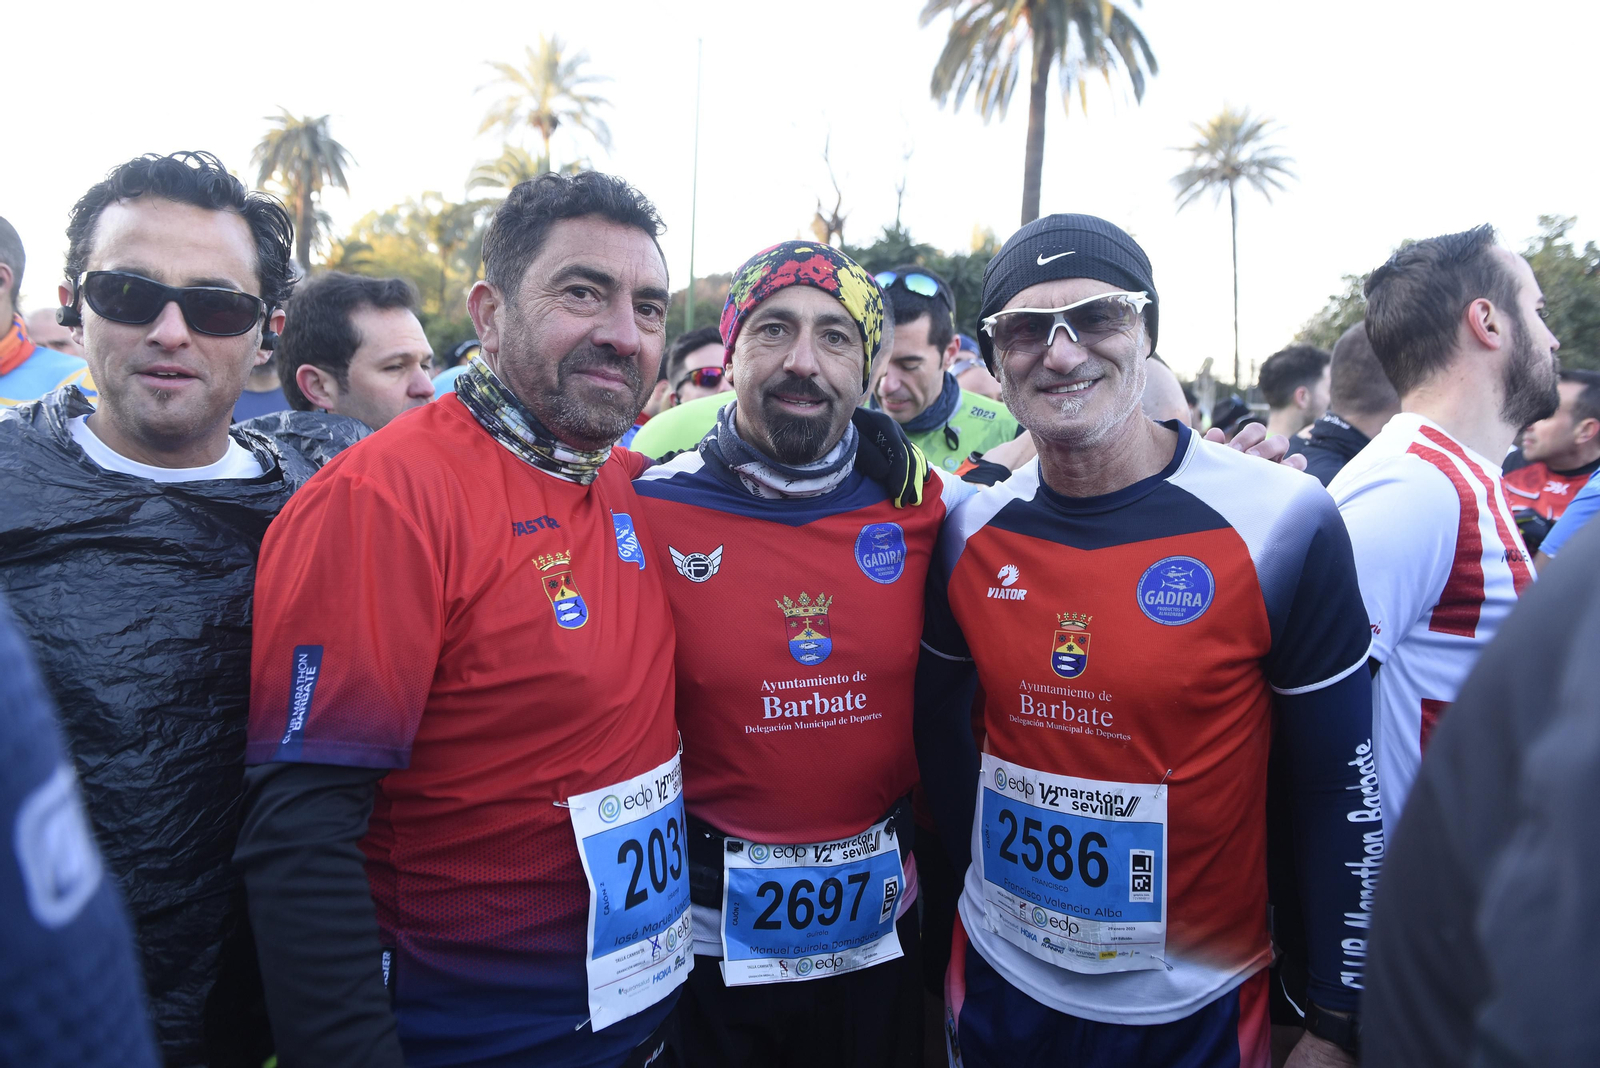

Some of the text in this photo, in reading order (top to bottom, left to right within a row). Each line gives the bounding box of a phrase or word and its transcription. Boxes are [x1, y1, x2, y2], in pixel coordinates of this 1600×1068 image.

[971, 406, 996, 420] 2023
[863, 550, 902, 568] GADIRA
[987, 587, 1028, 600] VIATOR
[1144, 590, 1202, 607] GADIRA
[760, 671, 867, 693] Ayuntamiento de
[1019, 680, 1112, 702] Ayuntamiento de
[292, 666, 317, 731] BARBATE
[761, 689, 867, 720] Barbate
[1020, 693, 1114, 727] Barbate
[745, 721, 792, 734] Delegación
[794, 718, 837, 730] Municipal
[850, 711, 883, 725] Deportes
[1009, 714, 1131, 740] Delegación Municipal de Deportes
[1009, 776, 1034, 798] edp
[1055, 786, 1123, 805] maratón
[1346, 738, 1382, 822] Barbate
[624, 784, 653, 810] edp
[1072, 801, 1124, 817] sevilla
[773, 844, 807, 861] edp
[830, 832, 873, 851] maratón
[843, 843, 876, 859] sevilla
[998, 809, 1108, 888] 2586
[1031, 877, 1069, 892] FRANCISCO
[753, 871, 870, 930] 2697
[1004, 878, 1042, 902] Francisco
[1044, 895, 1090, 915] Valencia
[1095, 907, 1123, 918] Alba
[614, 927, 639, 947] José
[806, 929, 829, 939] Guirola
[1021, 927, 1038, 943] HOKA
[1050, 916, 1079, 937] edp
[750, 945, 790, 955] Manuel
[793, 943, 828, 956] Guirola
[815, 953, 844, 970] edp
[653, 966, 671, 984] HOKA
